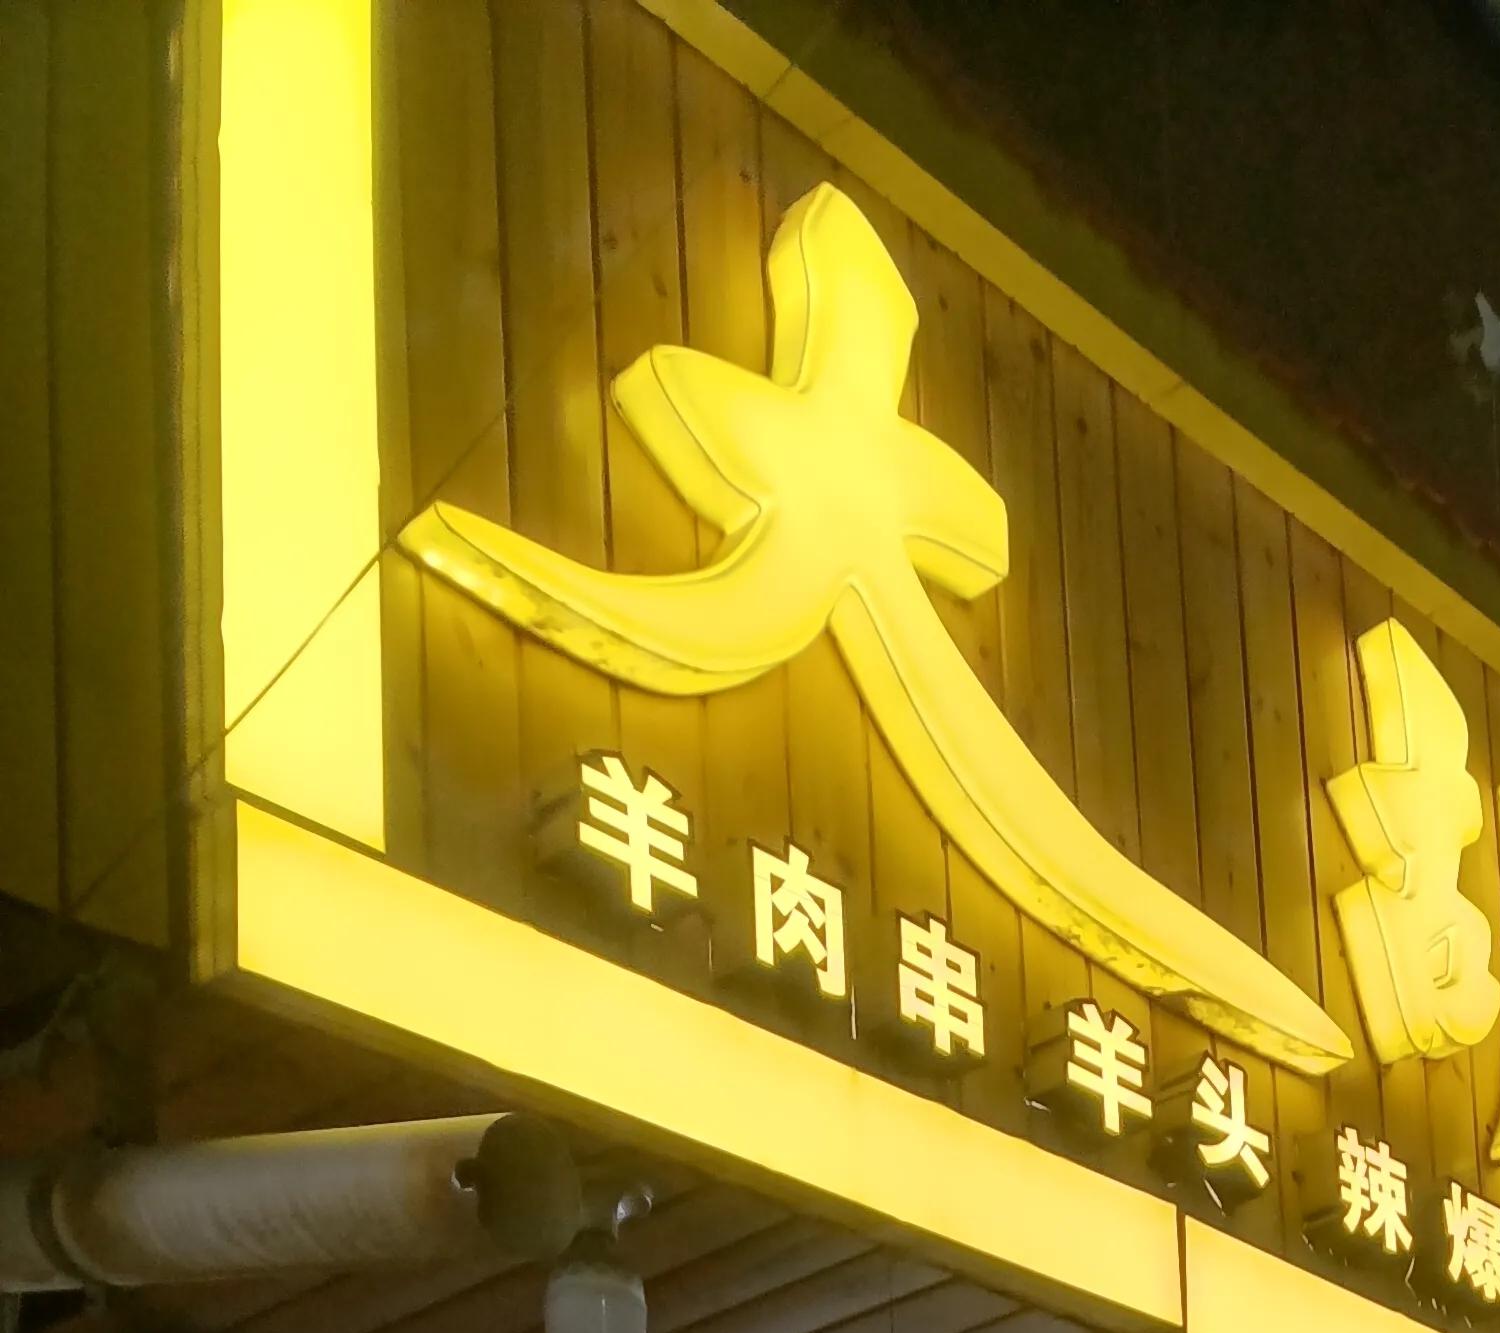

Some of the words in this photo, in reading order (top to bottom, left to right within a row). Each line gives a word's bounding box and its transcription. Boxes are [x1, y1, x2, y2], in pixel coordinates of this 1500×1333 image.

[578, 755, 985, 1057] 羊肉串
[1066, 1002, 1270, 1189] 羊头
